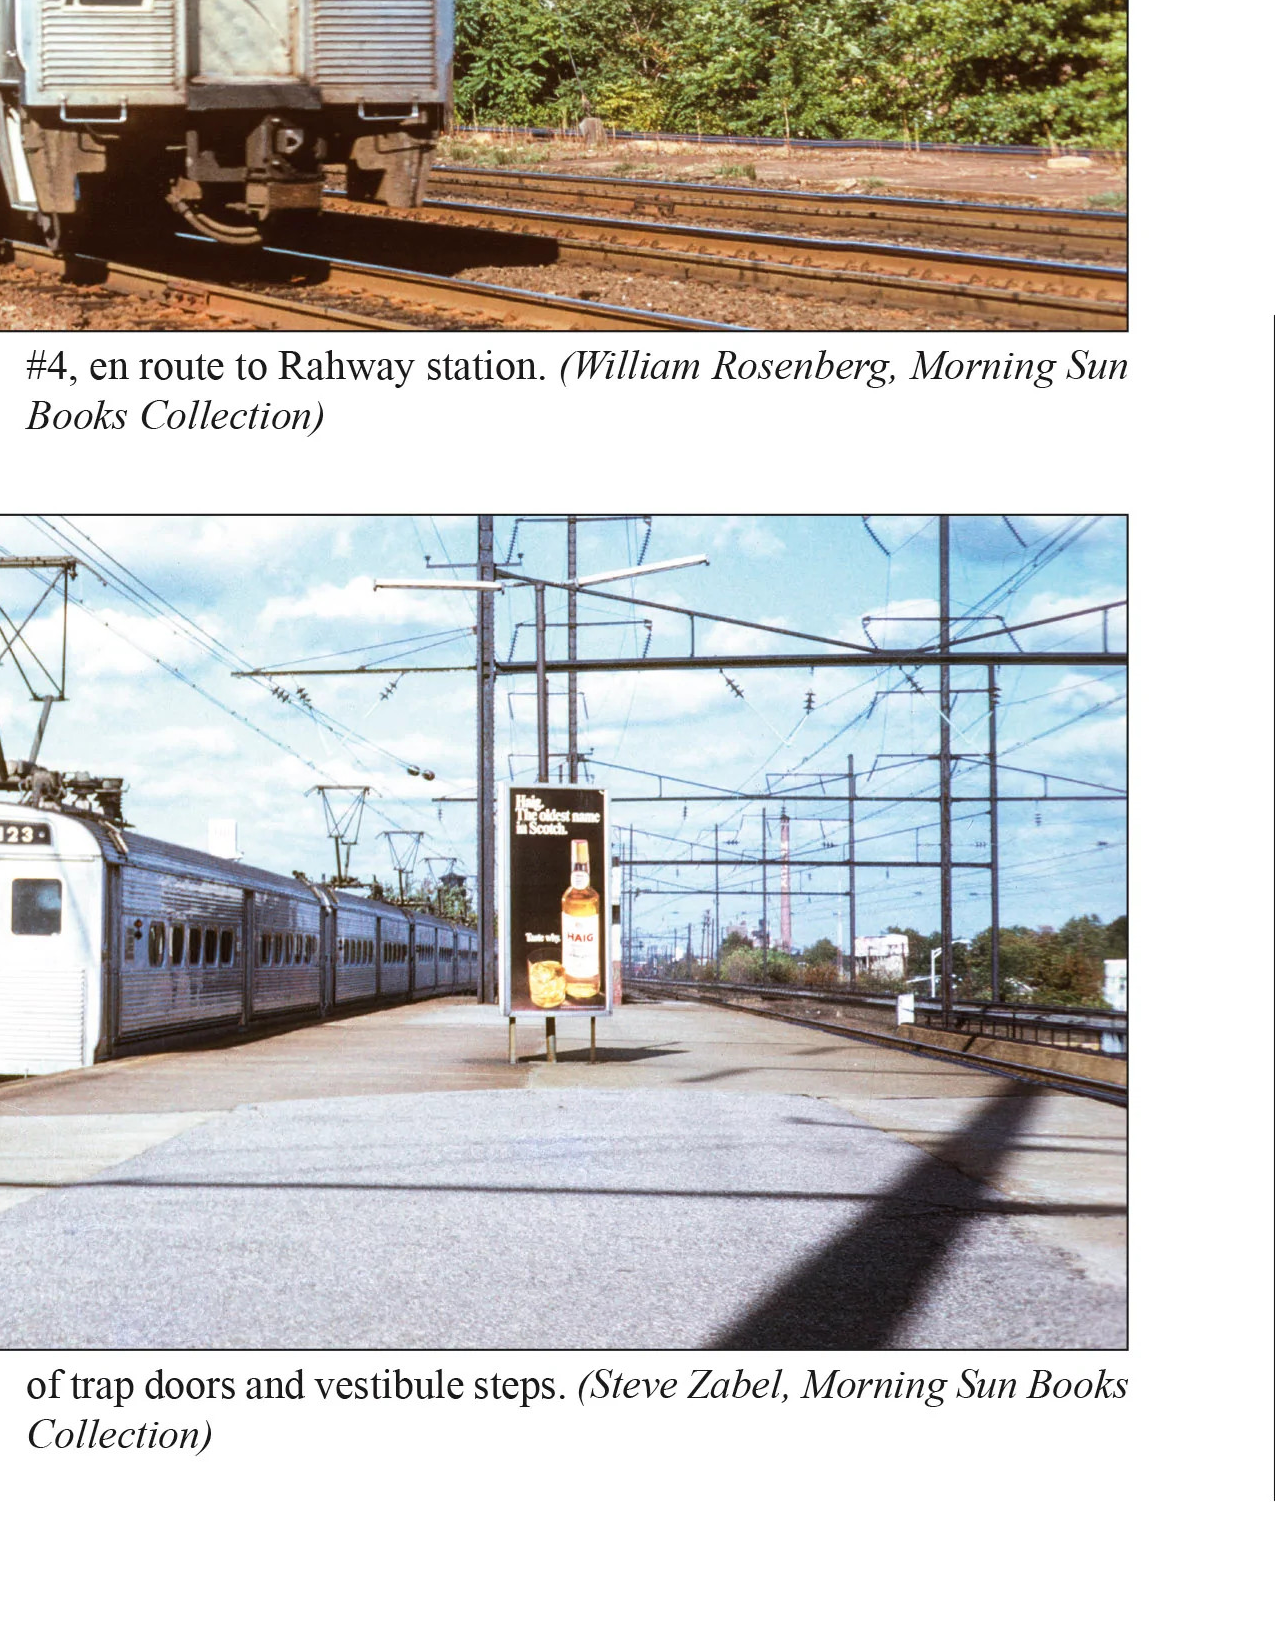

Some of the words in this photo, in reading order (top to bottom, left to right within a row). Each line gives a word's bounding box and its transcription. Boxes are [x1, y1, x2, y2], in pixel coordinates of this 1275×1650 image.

[27, 350, 76, 386] #4,
[90, 359, 129, 380] en
[139, 354, 223, 380] route
[235, 354, 267, 380] to
[278, 350, 415, 388] Rahway
[428, 350, 545, 380] station.
[561, 350, 699, 387] (William
[711, 350, 895, 388] Rosenberg,
[909, 351, 1057, 388] Morning
[1066, 350, 1127, 379] Sun
[25, 400, 127, 429] Books
[142, 400, 323, 437] Collection)
[515, 808, 538, 821] The
[539, 809, 570, 822] oldest
[571, 812, 601, 823] name
[516, 821, 528, 834] in
[529, 821, 568, 835] Scotch.
[567, 933, 594, 942] HAIG
[27, 1369, 65, 1399] of
[70, 1373, 134, 1407] trap
[145, 1369, 235, 1399] doors
[246, 1369, 305, 1399] and
[314, 1369, 463, 1399] vestibule
[475, 1373, 565, 1407] steps.
[579, 1369, 677, 1406] (Steve
[687, 1369, 788, 1403] Zabel,
[800, 1370, 948, 1407] Morning
[956, 1369, 1016, 1398] Sun
[1026, 1369, 1128, 1398] Books
[29, 1419, 211, 1456] Collection)
